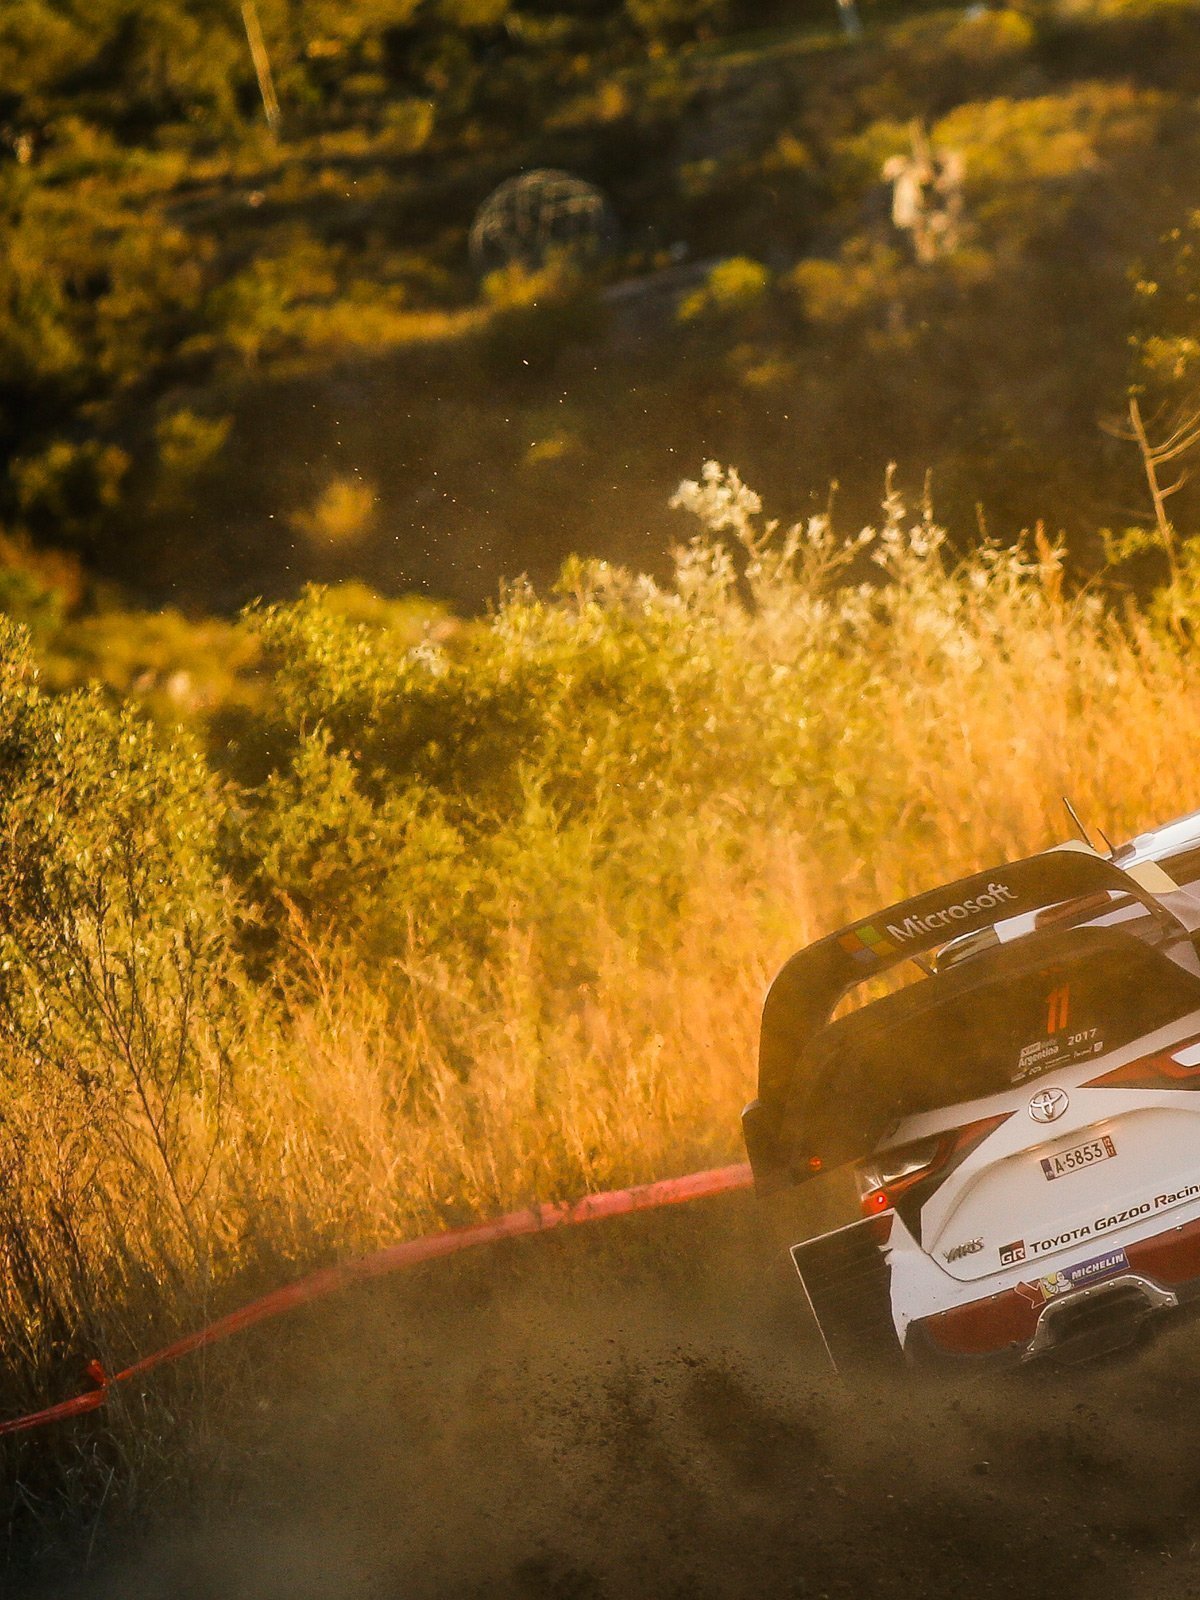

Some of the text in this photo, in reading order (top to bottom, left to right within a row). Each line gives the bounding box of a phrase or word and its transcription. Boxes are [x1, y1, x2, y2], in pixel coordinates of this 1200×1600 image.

[886, 882, 1019, 942] Microsoft
[1046, 982, 1070, 1034] 11
[1067, 1028, 1097, 1046] 2017
[1018, 1046, 1059, 1068] Argentina
[1001, 1247, 1026, 1265] GR
[1030, 1226, 1091, 1253] TOYOTA
[1094, 1202, 1151, 1231] GAZOO
[1071, 1253, 1125, 1280] MICHELIN
